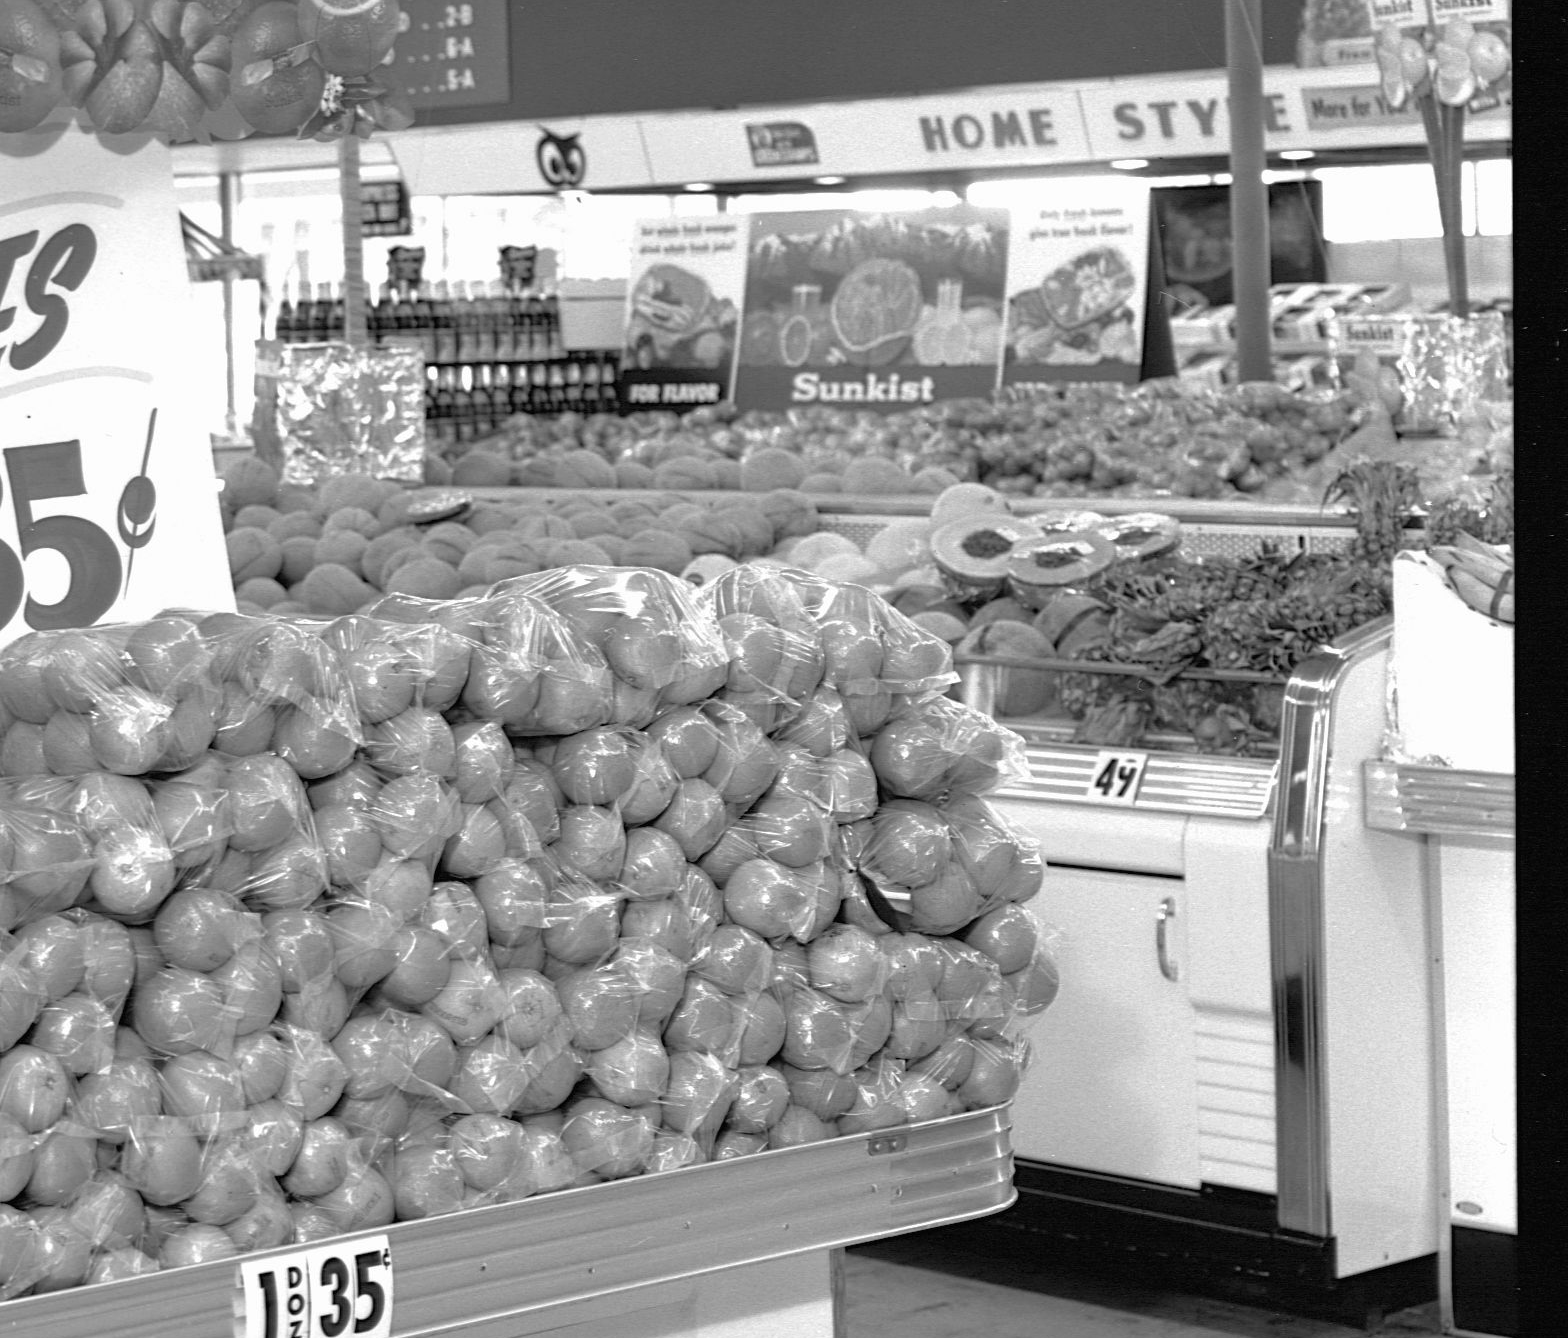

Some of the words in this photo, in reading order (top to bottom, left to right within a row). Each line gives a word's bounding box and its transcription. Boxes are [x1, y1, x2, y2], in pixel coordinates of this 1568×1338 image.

[920, 109, 1058, 153] HOME
[1113, 93, 1292, 142] STYE
[662, 381, 721, 404] FLAVOR
[792, 371, 934, 404] Sunkist
